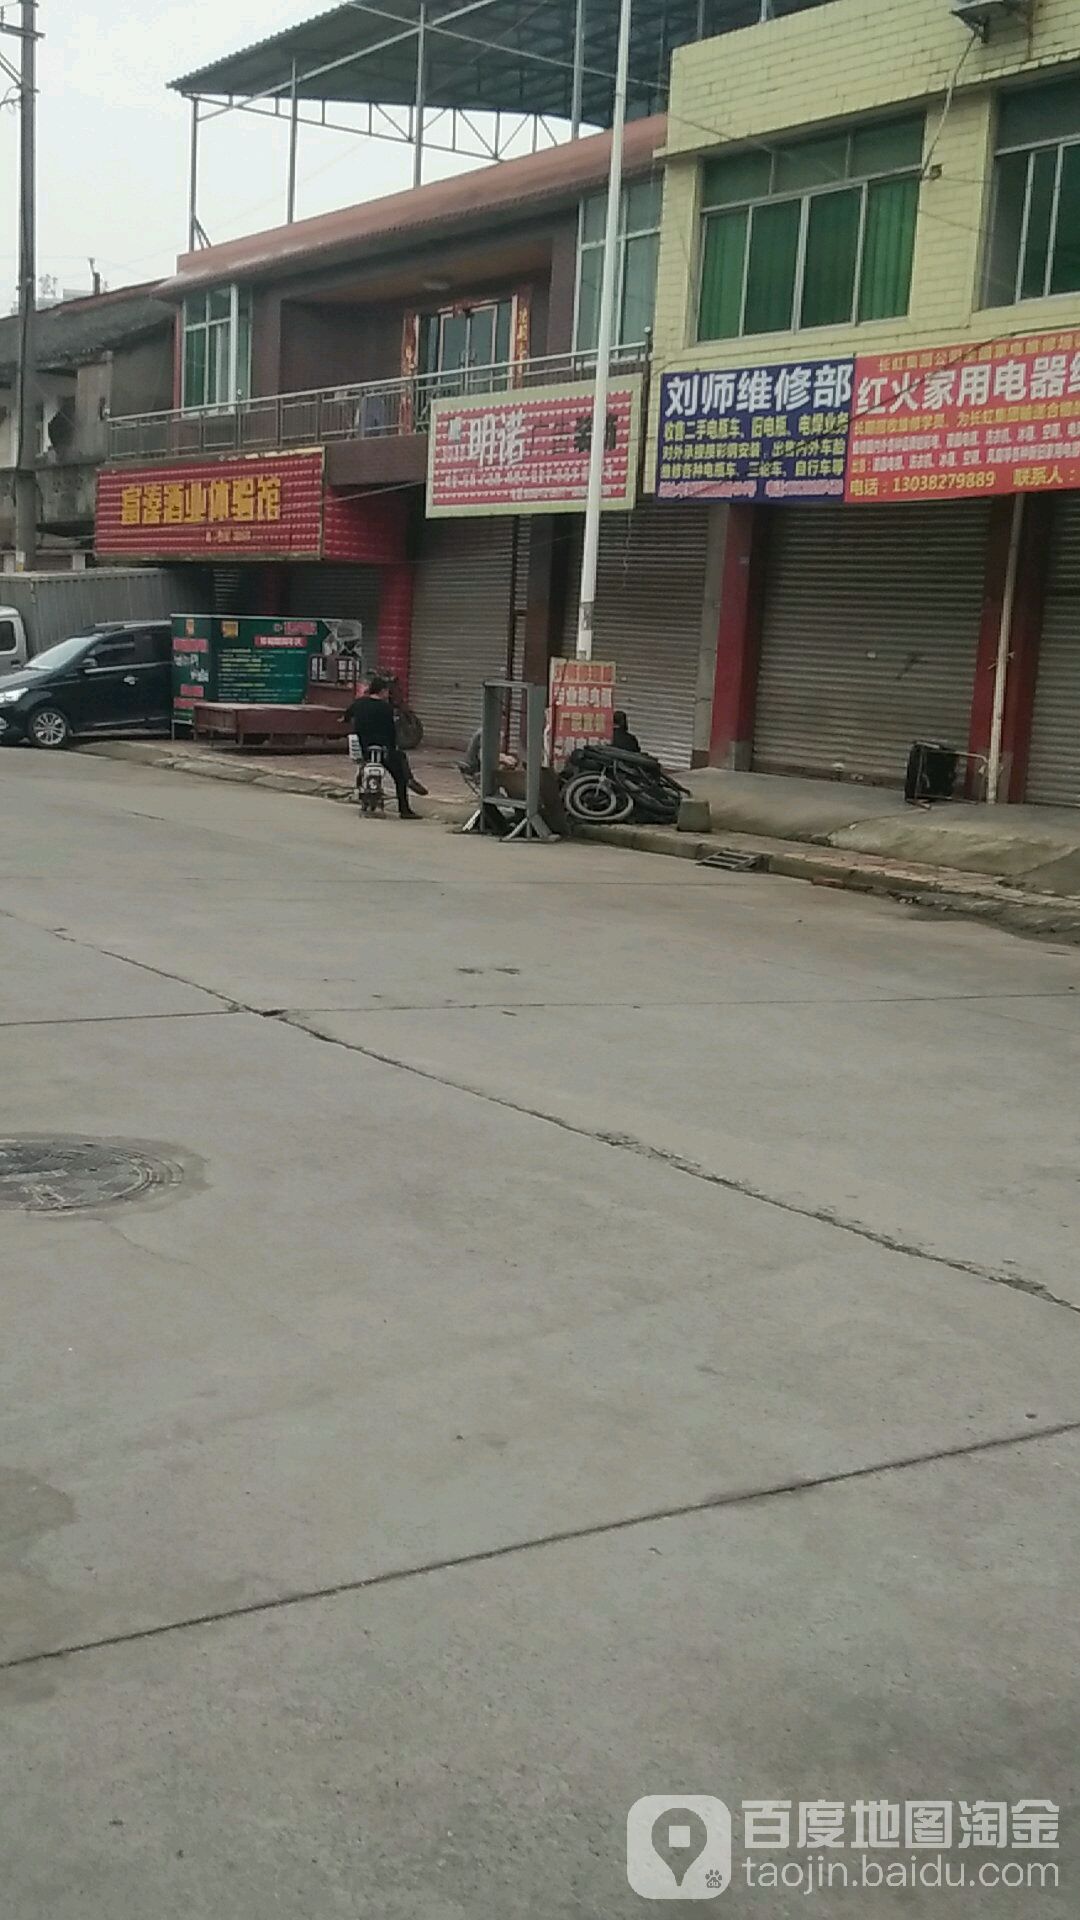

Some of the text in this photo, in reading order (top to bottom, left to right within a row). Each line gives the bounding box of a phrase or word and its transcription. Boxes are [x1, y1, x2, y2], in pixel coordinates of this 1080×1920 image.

[665, 364, 853, 417] 刘师维修部
